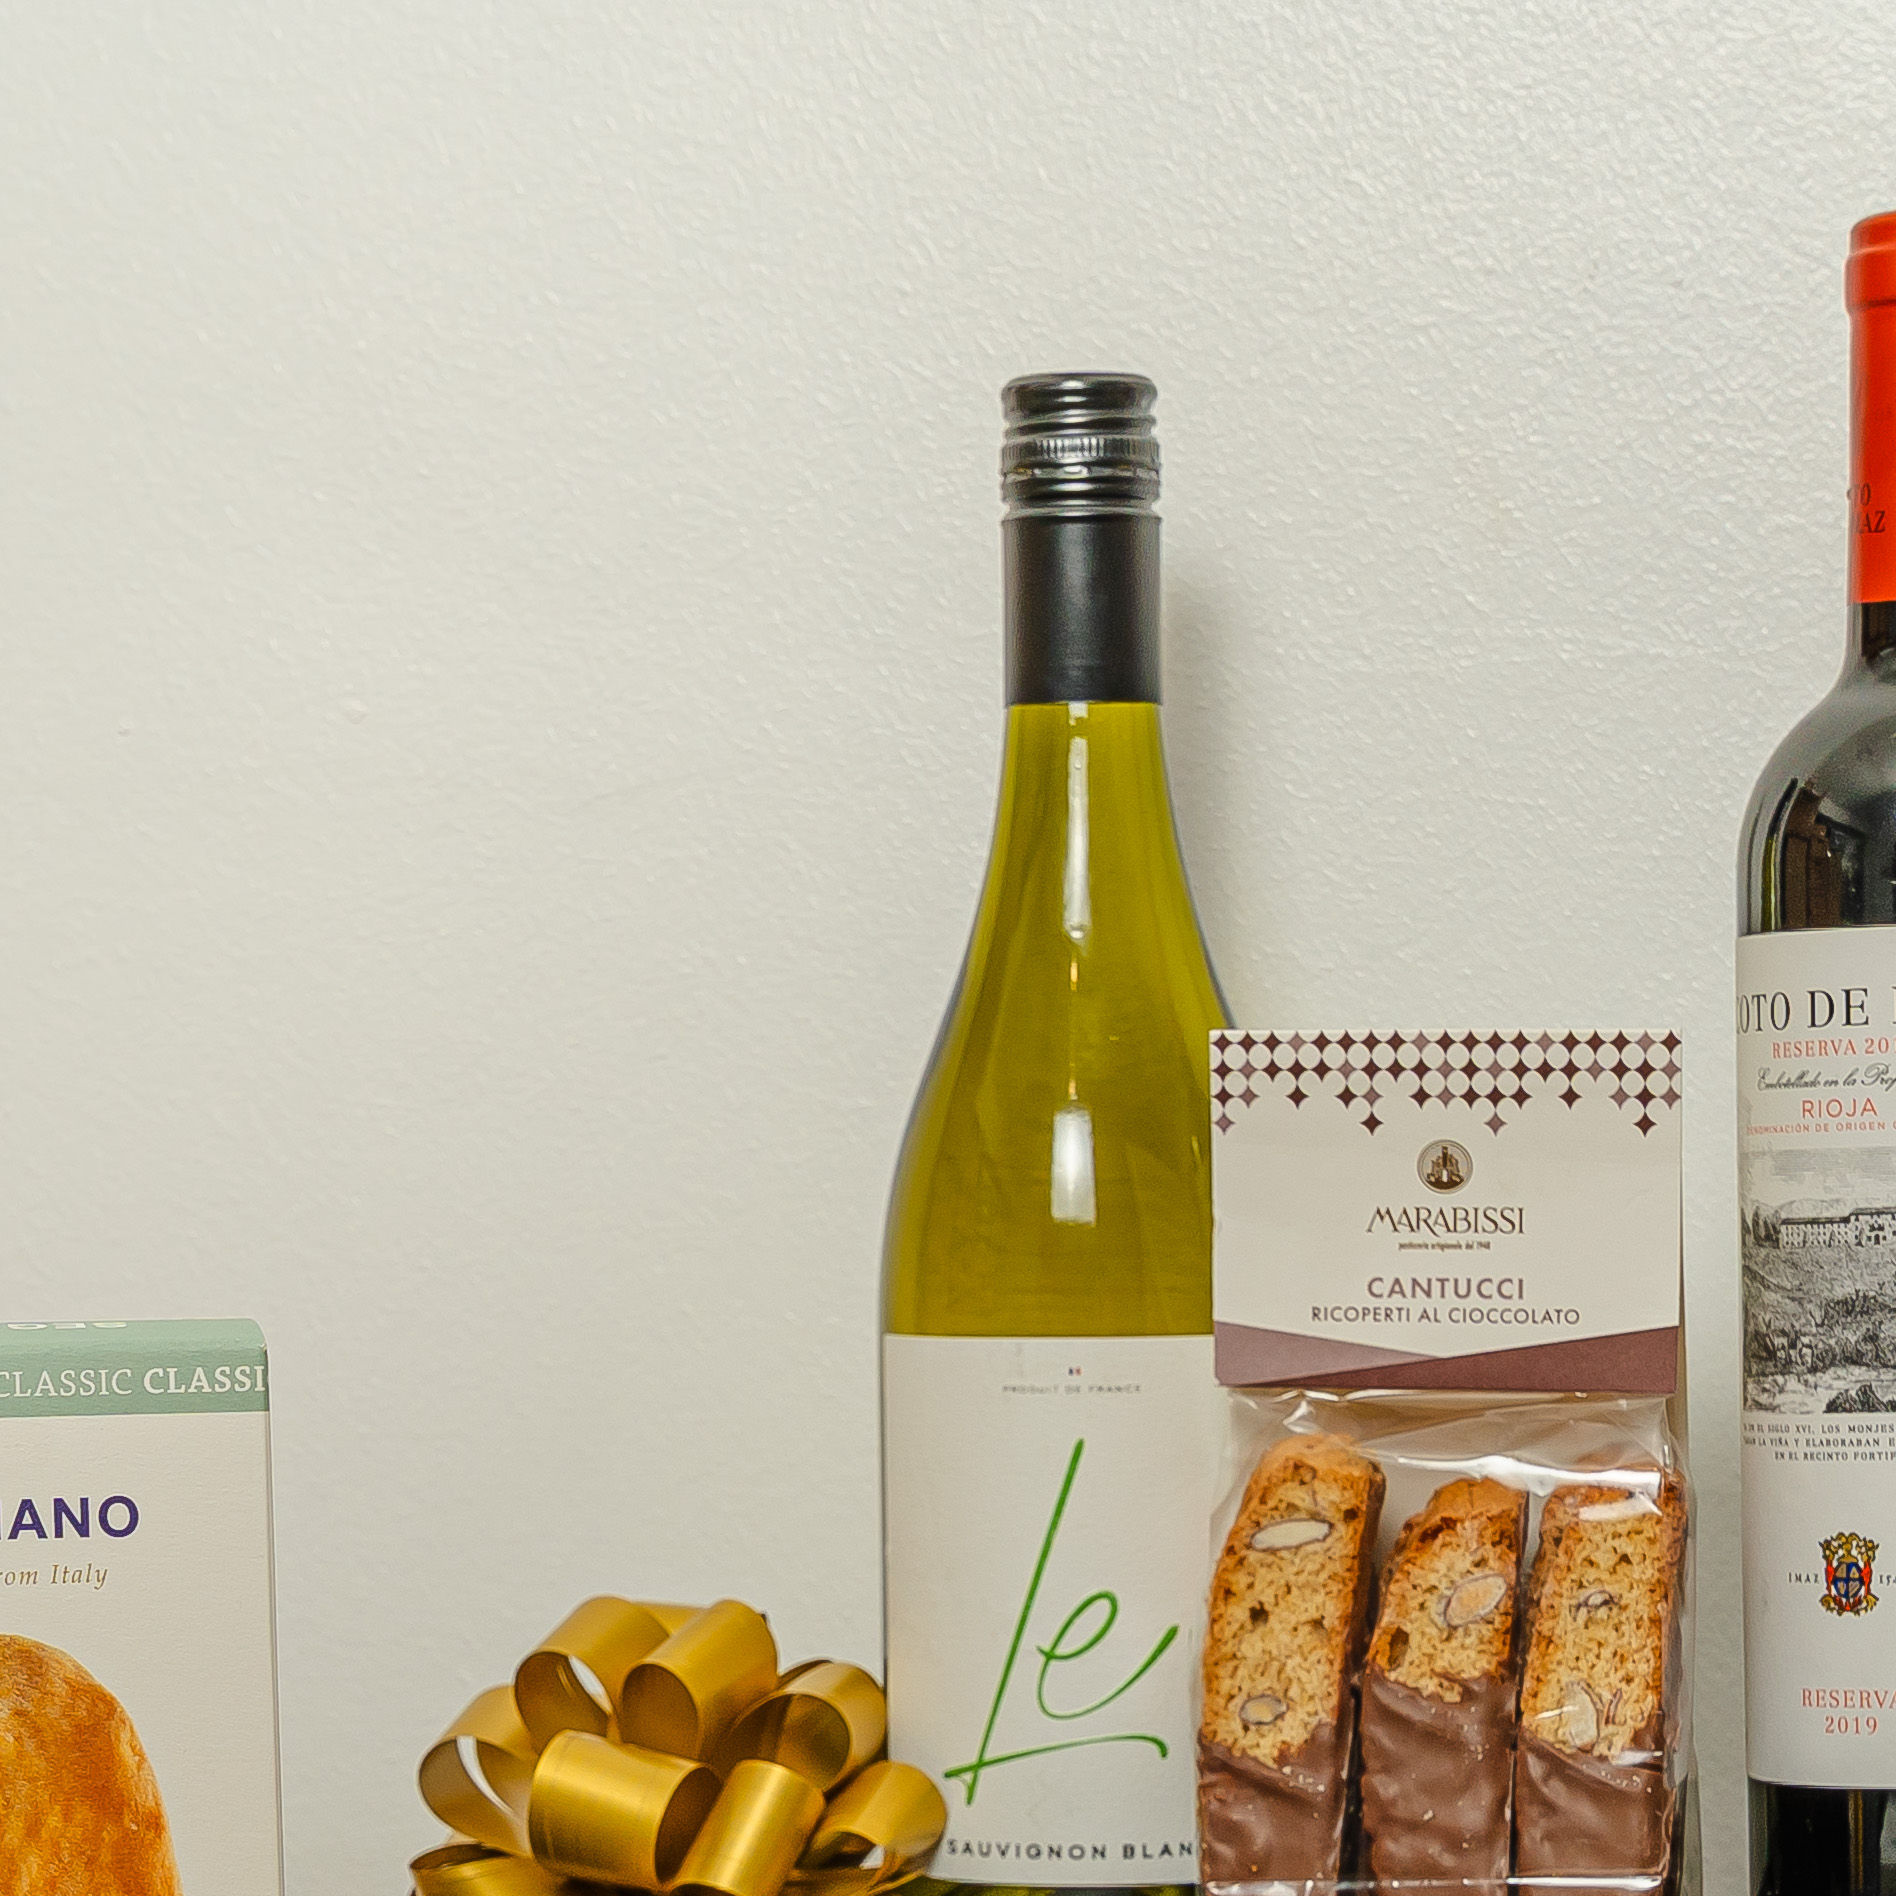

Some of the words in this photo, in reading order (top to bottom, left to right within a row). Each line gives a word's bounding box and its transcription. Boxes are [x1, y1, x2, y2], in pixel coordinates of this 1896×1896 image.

[1807, 987, 1869, 1029] DE
[1772, 1040, 1857, 1059] RESERVA
[1802, 1098, 1877, 1120] RIOJA
[1366, 1206, 1525, 1238] MARABISSI
[1367, 1277, 1525, 1300] CANTUCCI
[1312, 1306, 1410, 1324] RICOPERTI
[1418, 1307, 1441, 1324] AL
[1448, 1307, 1580, 1325] CIOCCOLATO
[51, 1563, 108, 1589] Italy
[1825, 1716, 1878, 1735] 2019
[946, 1839, 1107, 1860] SAUVIGNON
